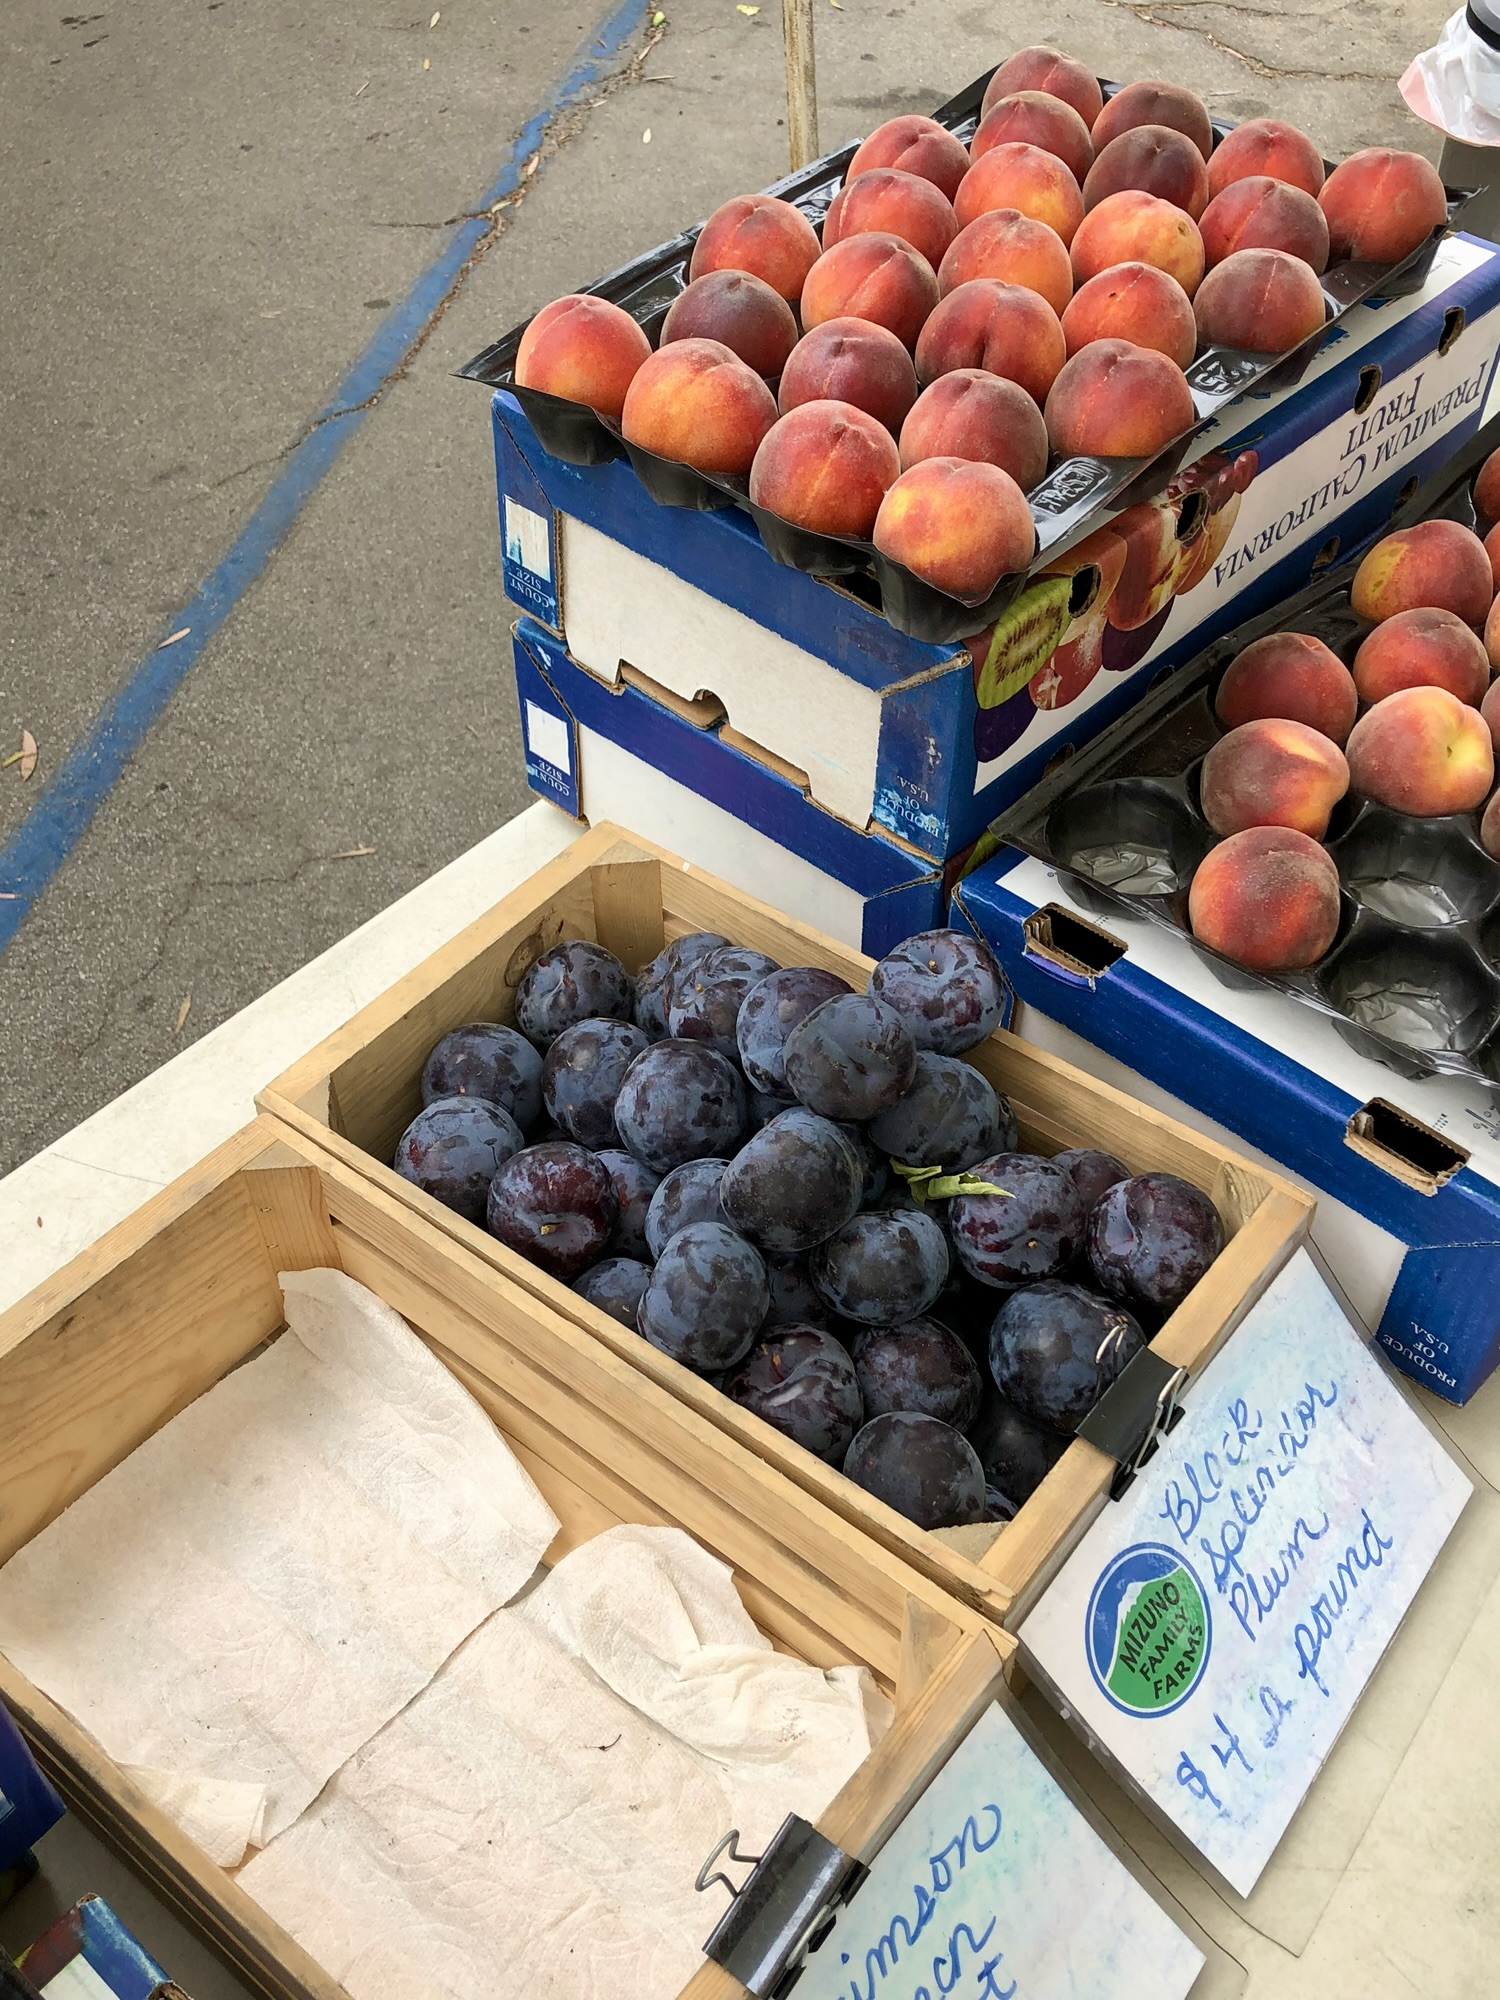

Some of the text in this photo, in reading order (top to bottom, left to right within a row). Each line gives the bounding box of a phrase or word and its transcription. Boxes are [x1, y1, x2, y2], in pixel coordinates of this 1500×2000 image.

[1340, 372, 1425, 461] FRUIT
[1214, 360, 1488, 588] PREMIUM CALIFORNIA
[510, 578, 549, 608] COUNT
[516, 571, 542, 590] SIZE
[534, 768, 570, 797] COUNT
[538, 759, 562, 781] SIZE
[896, 775, 929, 802] U.S.A.
[881, 794, 940, 838] PRODUCE
[903, 795, 920, 810] OF
[1410, 1321, 1450, 1355] U.S.A.
[1412, 1341, 1436, 1359] OF
[1382, 1334, 1457, 1388] PRODUCE
[1229, 1511, 1330, 1643] Plum
[1294, 1508, 1394, 1698] pound
[1119, 1581, 1181, 1674] MIZUNO
[1139, 1606, 1189, 1682] FAMILY
[1153, 1625, 1203, 1700] FARMS
